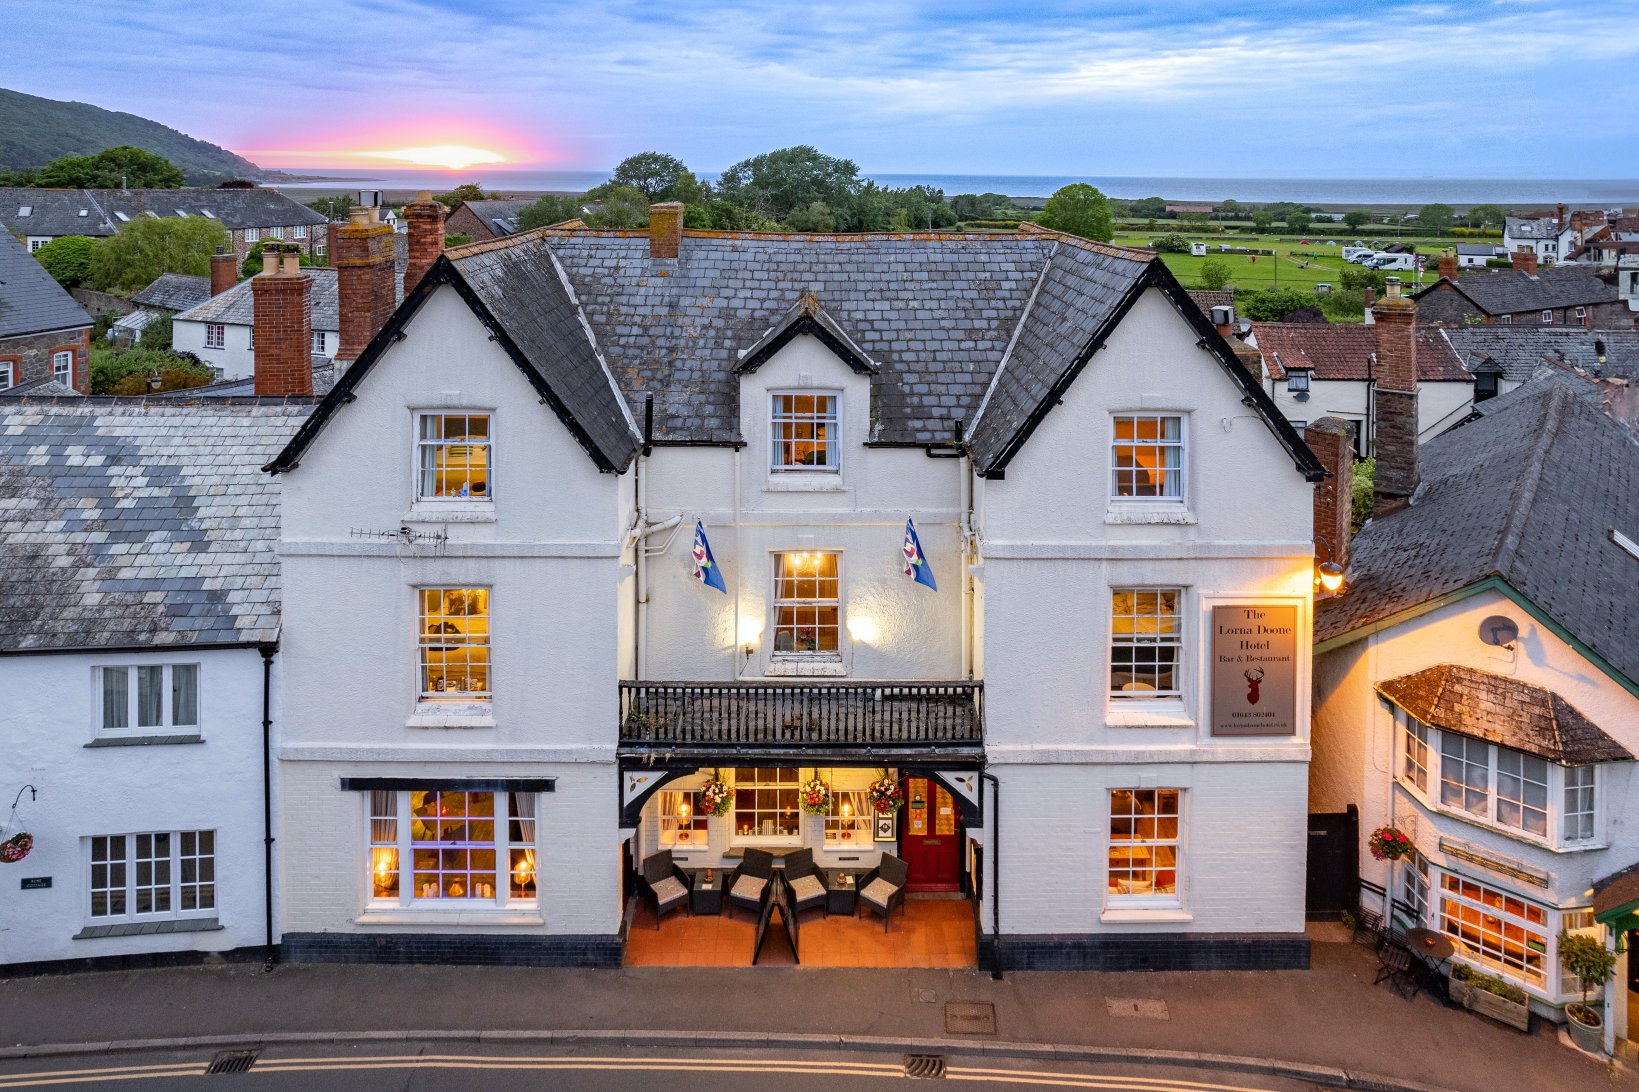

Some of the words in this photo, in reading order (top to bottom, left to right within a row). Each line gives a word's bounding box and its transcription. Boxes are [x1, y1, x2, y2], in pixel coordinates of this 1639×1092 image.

[1244, 609, 1266, 619] The
[1219, 625, 1252, 635] Lorna
[1257, 625, 1292, 635] Doone
[1240, 640, 1270, 650] Hotel
[1219, 655, 1234, 663] Bar
[1236, 655, 1243, 663] &
[1246, 654, 1290, 662] Restaurant
